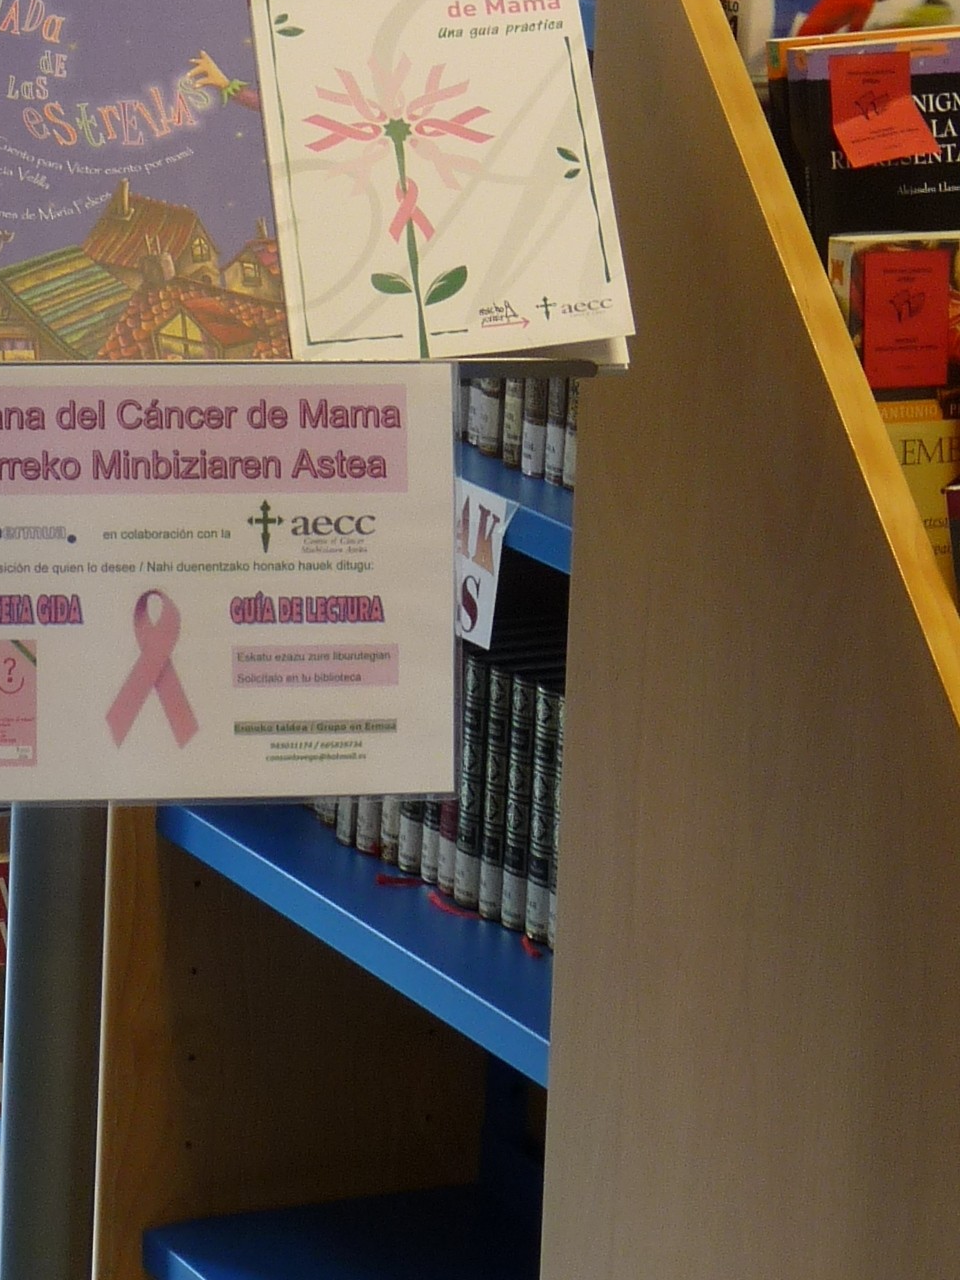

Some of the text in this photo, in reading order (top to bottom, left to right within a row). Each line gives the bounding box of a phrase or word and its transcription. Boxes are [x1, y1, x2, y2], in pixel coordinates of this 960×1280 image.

[447, 0, 478, 19] de
[438, 27, 464, 39] Una
[932, 119, 958, 138] LA
[36, 158, 63, 170] para
[144, 160, 163, 175] por
[21, 207, 36, 221] de
[561, 297, 614, 315] aecc
[56, 399, 106, 430] del
[116, 398, 240, 431] Cáncer
[246, 399, 289, 430] de
[298, 398, 402, 429] Mama
[92, 449, 283, 481] Minbiziaren
[291, 449, 388, 480] Astea
[102, 528, 231, 540] en colaboración con la
[290, 515, 376, 536] aecc
[33, 562, 49, 574] de
[52, 562, 84, 576] quien
[87, 562, 98, 573] lo
[101, 562, 136, 573] desee
[147, 561, 173, 572] Nahi
[176, 561, 250, 572] duenentzako
[253, 561, 295, 572] honako
[298, 560, 333, 571] hauek
[37, 594, 84, 625] GIDA
[230, 590, 385, 625] GUÍA DE LECTURA
[237, 651, 391, 663] Eskatu ezazu zure liburutegian
[285, 674, 300, 683] en
[314, 672, 362, 683] biblioteca
